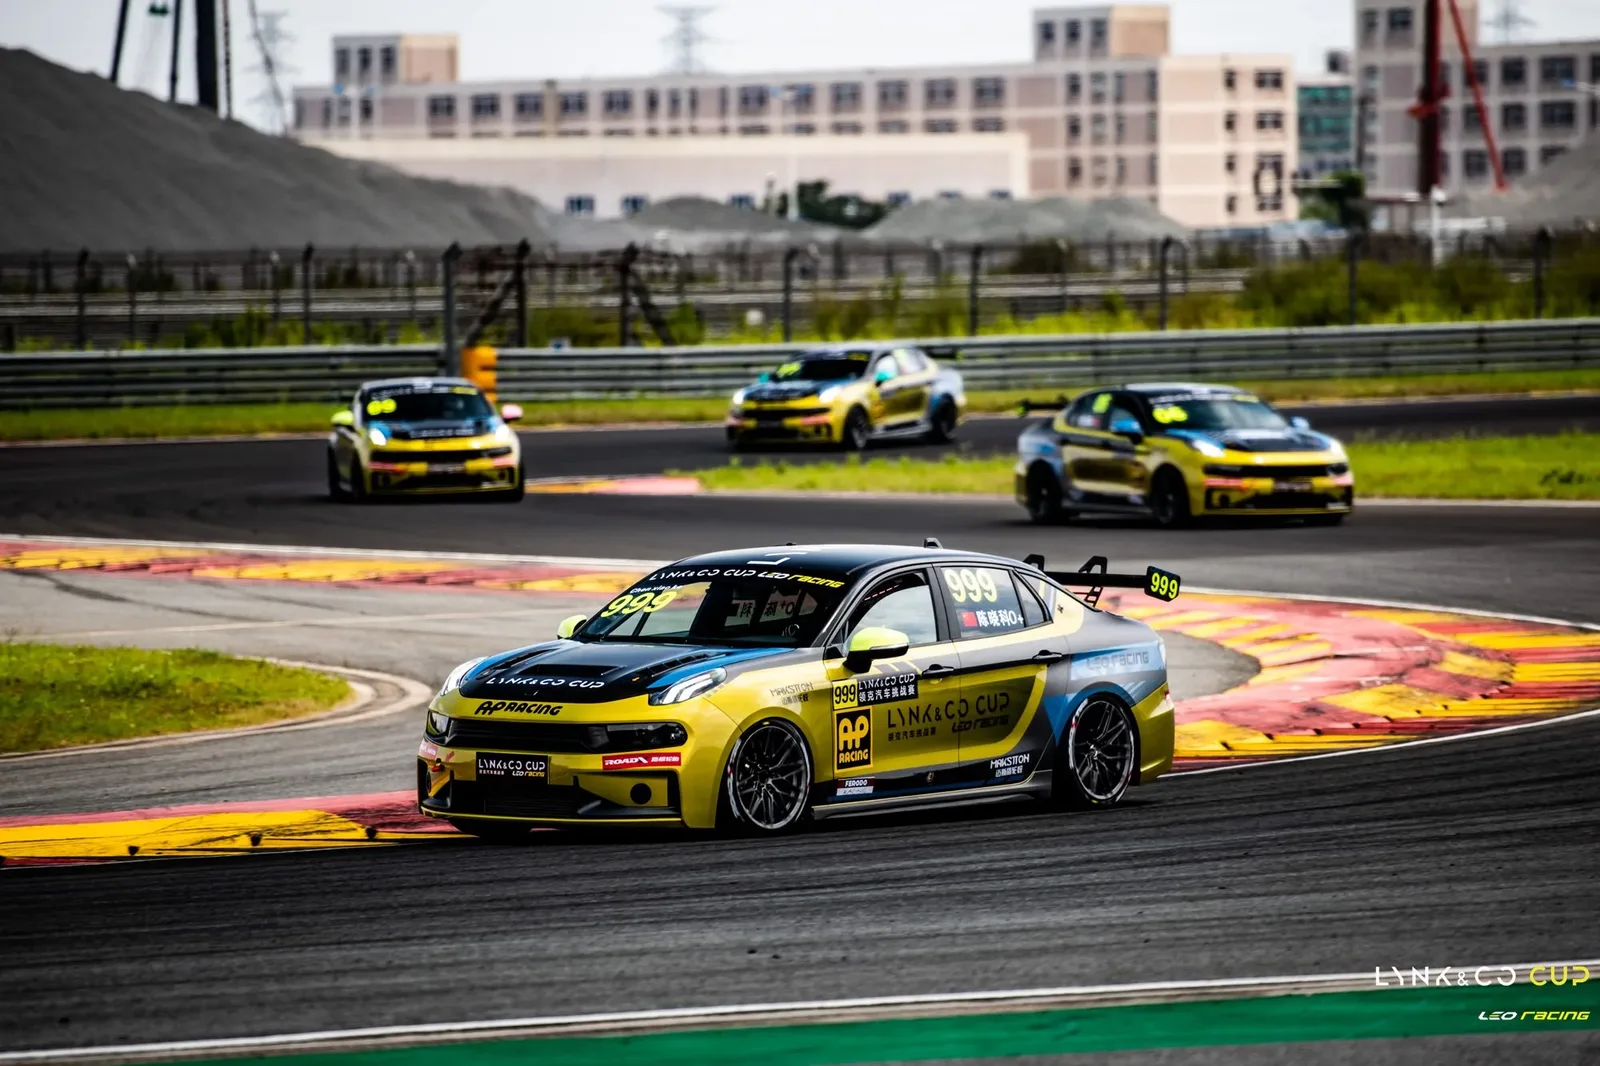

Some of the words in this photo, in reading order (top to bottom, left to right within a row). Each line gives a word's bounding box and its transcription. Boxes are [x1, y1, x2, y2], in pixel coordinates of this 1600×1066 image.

[723, 569, 756, 577] CUP
[758, 571, 789, 579] LEO
[788, 574, 845, 588] racing
[944, 568, 998, 602] 999
[1150, 572, 1178, 599] 999
[600, 590, 677, 618] 999
[568, 679, 605, 688] CUP
[899, 673, 916, 684] CUP
[834, 683, 856, 704] 999
[859, 684, 916, 702] 领克汽车挑战赛
[474, 700, 507, 715] AP
[504, 702, 563, 716] RACING
[975, 692, 1010, 716] CUP
[838, 715, 869, 751] AP
[951, 721, 972, 733] LEO
[604, 756, 648, 765] ROADX
[838, 749, 869, 764] RACING
[525, 761, 546, 771] CUP
[844, 779, 868, 788] FERODO
